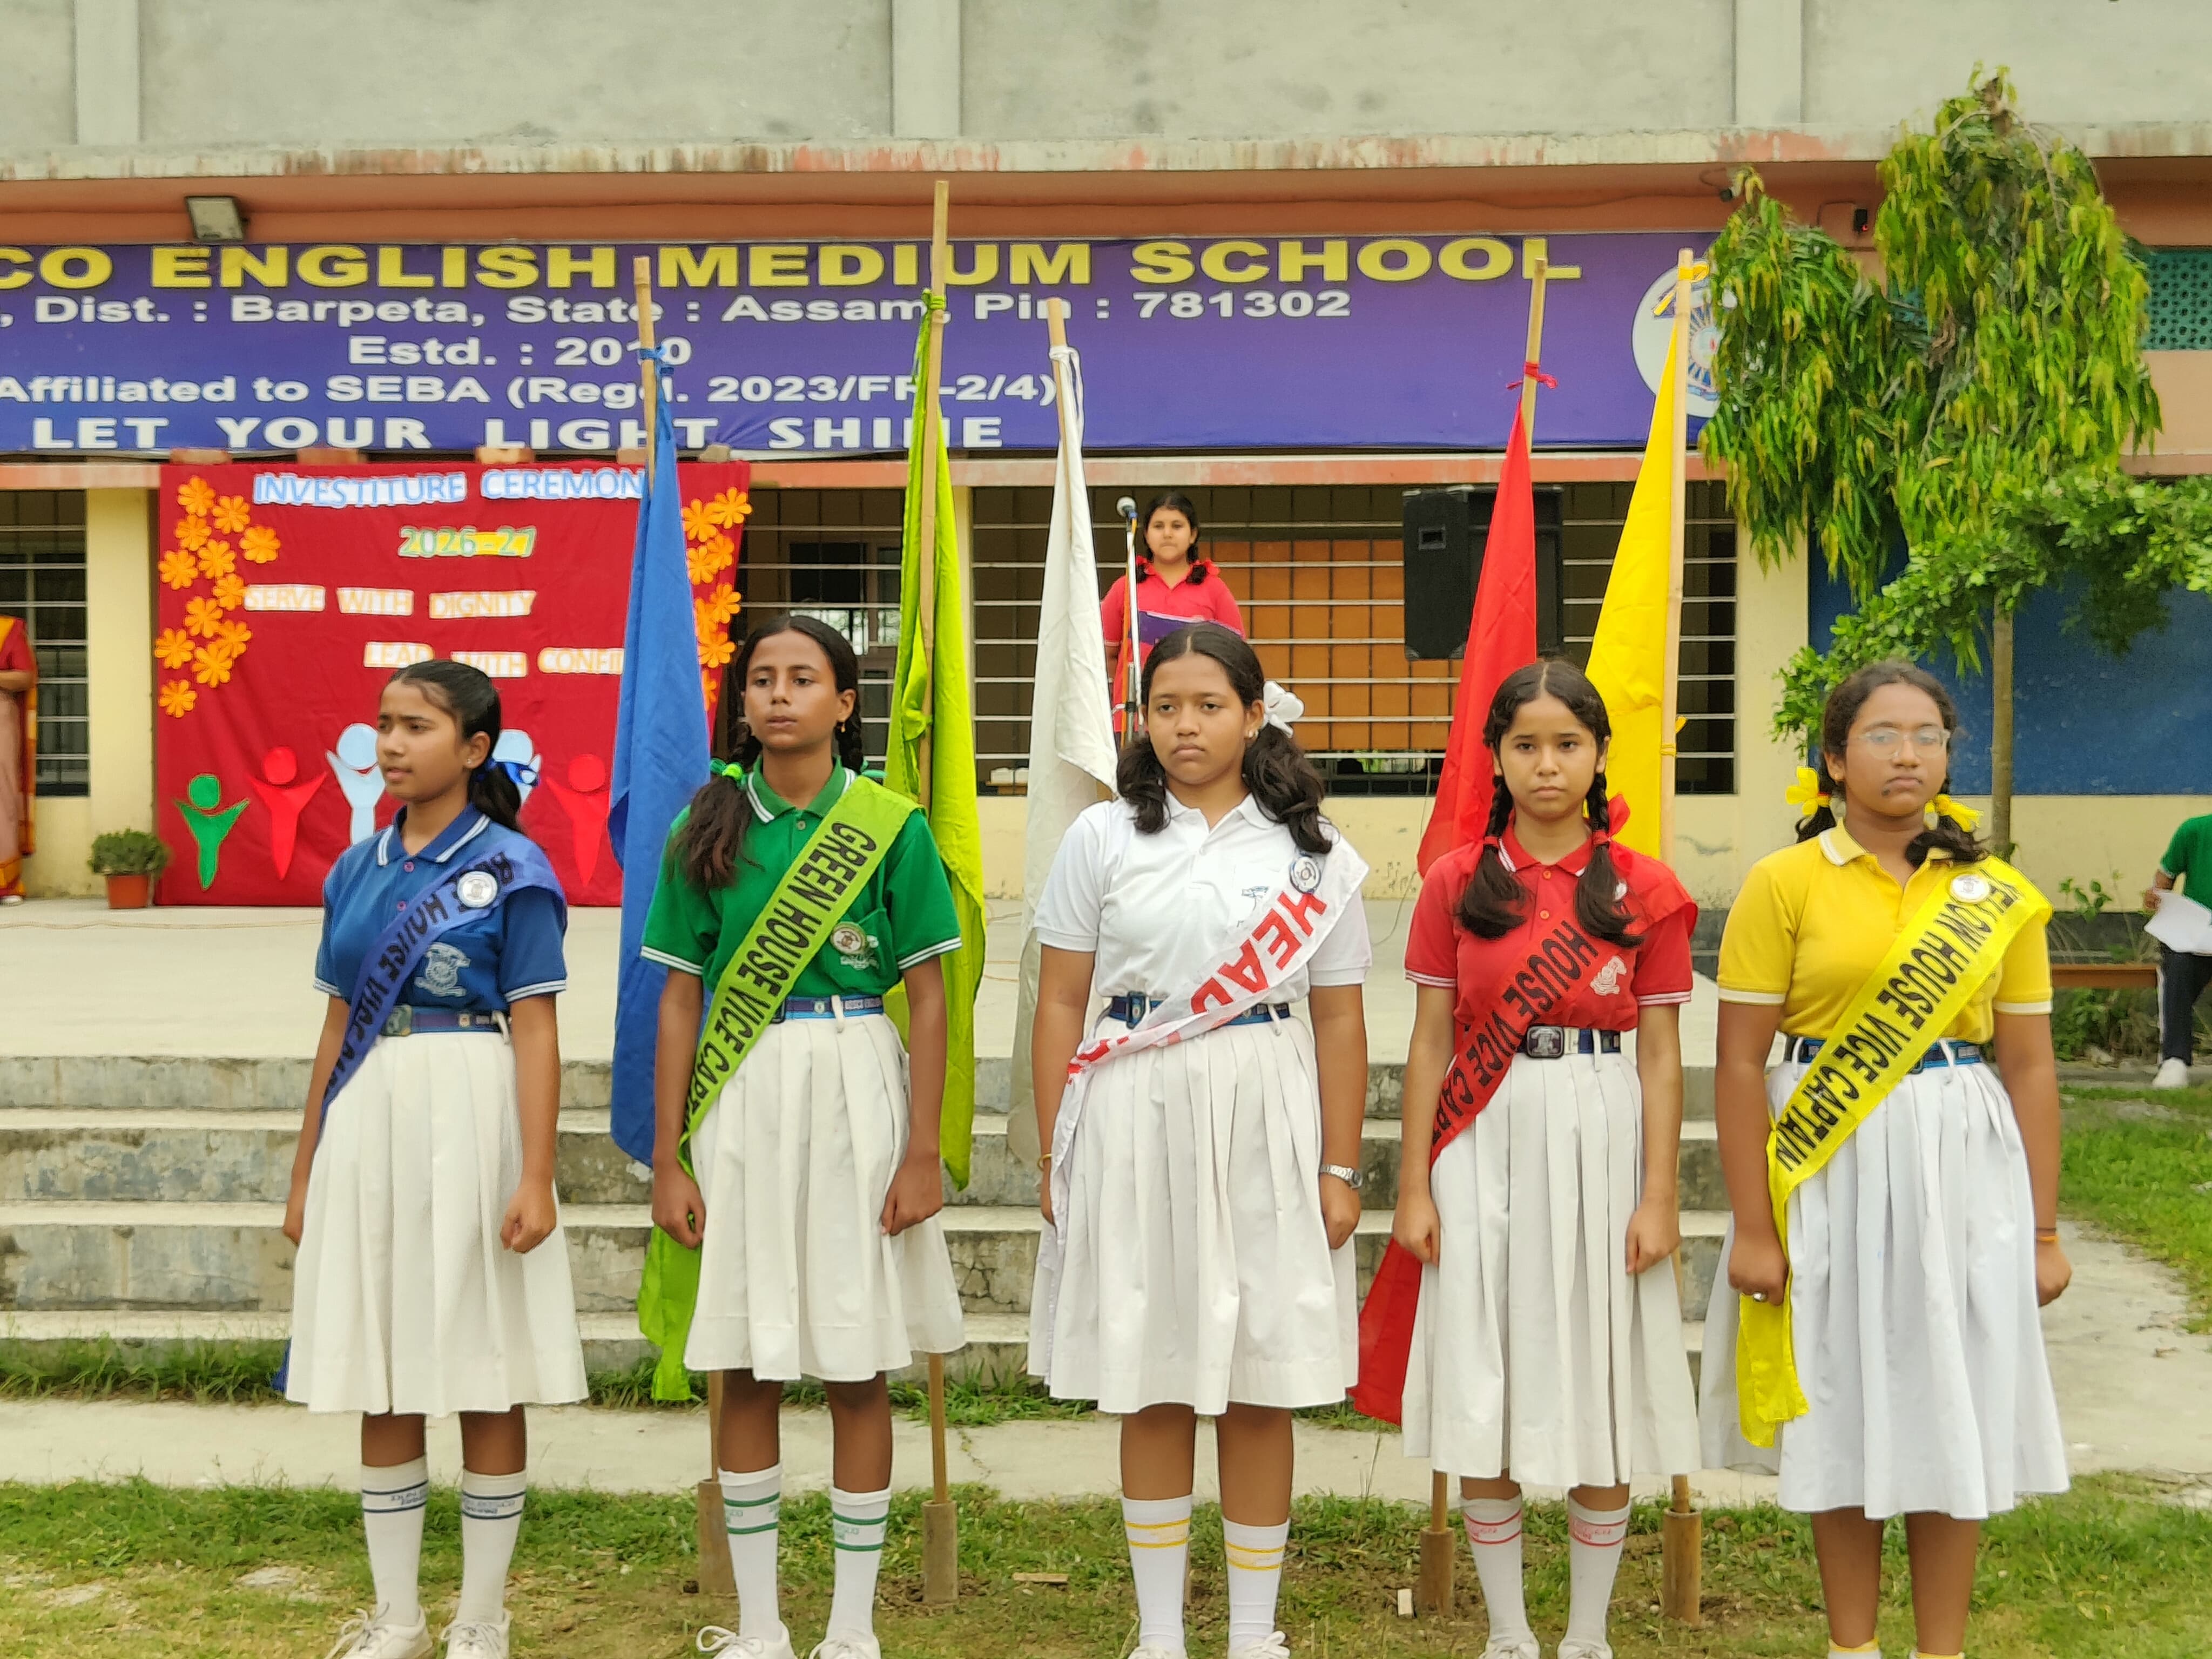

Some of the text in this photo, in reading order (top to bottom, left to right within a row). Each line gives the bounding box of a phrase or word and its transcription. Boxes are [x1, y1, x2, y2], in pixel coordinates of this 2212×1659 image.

[151, 245, 616, 289] ENGLISH
[658, 243, 1091, 287] MEDIUM
[1130, 238, 1582, 284] SCHOOL
[35, 296, 170, 323] Dist.
[230, 295, 485, 328] Barpeta,
[506, 295, 664, 323] State
[1132, 289, 1351, 319] 781302
[348, 335, 497, 366] Estd.
[554, 336, 692, 366] 200
[0, 375, 237, 403] Affiliated
[252, 376, 310, 403] to
[325, 374, 491, 403] SEBA
[32, 416, 170, 449] LET
[216, 416, 433, 449] YOUR
[255, 469, 645, 507] INVESTITURE CEREMON
[245, 585, 535, 618] SERVE WITH DIGNITY
[538, 648, 624, 673] CONFI
[786, 821, 878, 913] GREEN
[736, 898, 822, 997] HOUSE
[1500, 920, 1599, 1024] HOUSE
[1877, 930, 1969, 1030] HOUSE
[714, 985, 772, 1055] VICE
[1466, 1010, 1525, 1087] VICE
[1835, 1011, 1911, 1083] VICE
[1775, 1065, 1860, 1172] CAPTAIN
